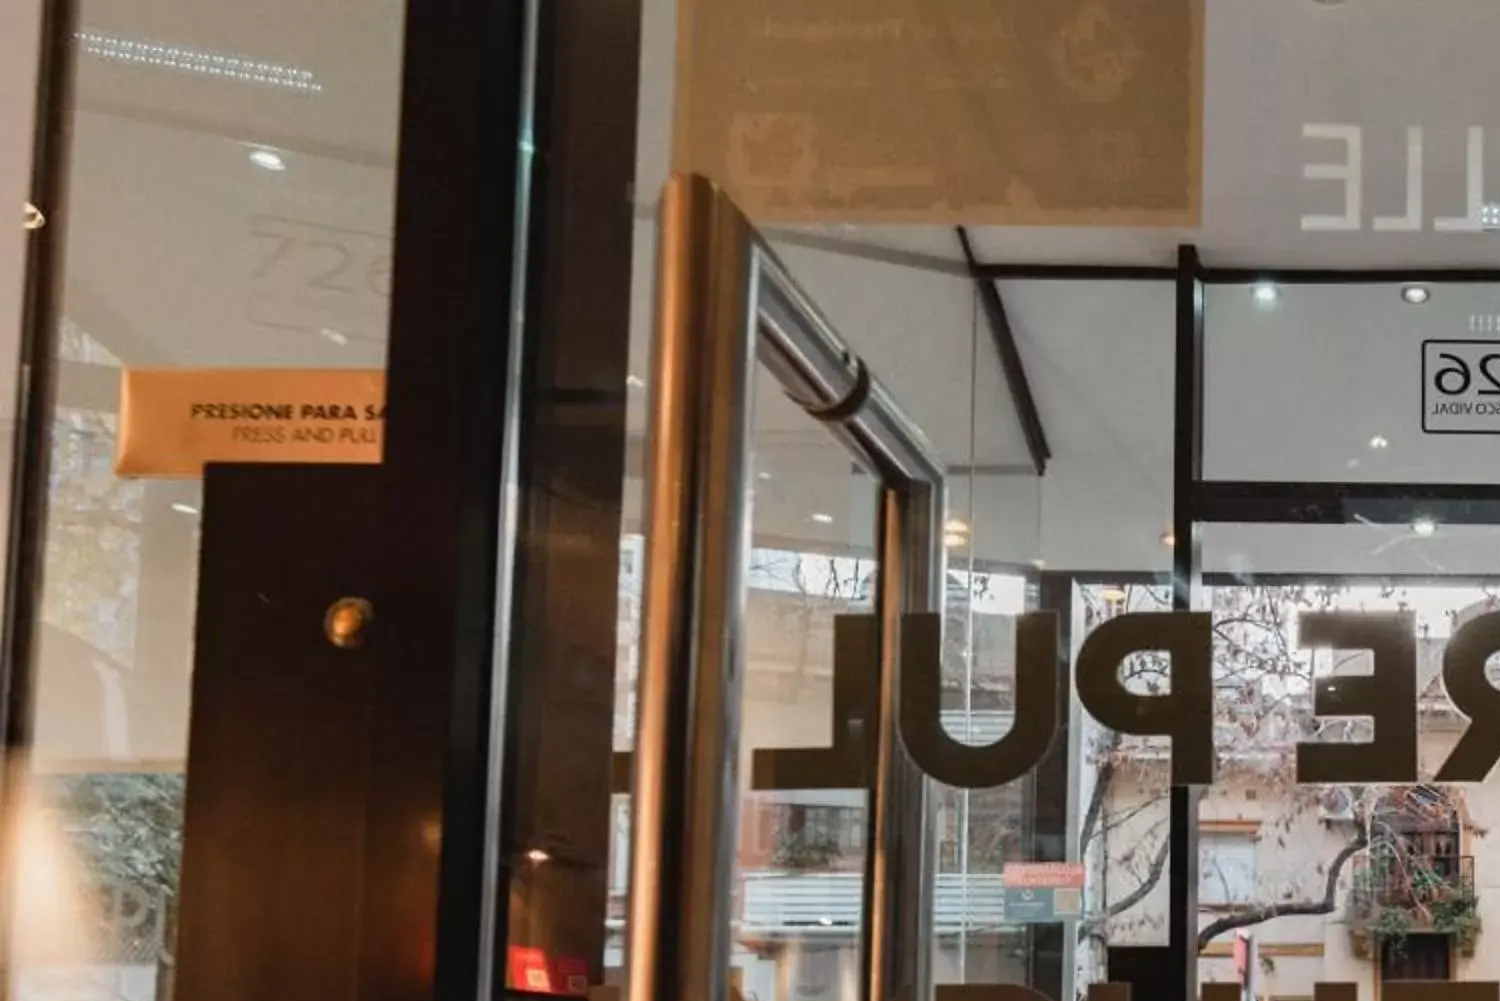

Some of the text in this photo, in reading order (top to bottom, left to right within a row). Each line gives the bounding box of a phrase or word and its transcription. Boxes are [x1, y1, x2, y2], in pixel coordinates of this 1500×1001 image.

[190, 403, 292, 420] PRESIONE
[301, 404, 357, 420] PARA
[232, 426, 285, 443] PRESS
[293, 427, 333, 443] AND
